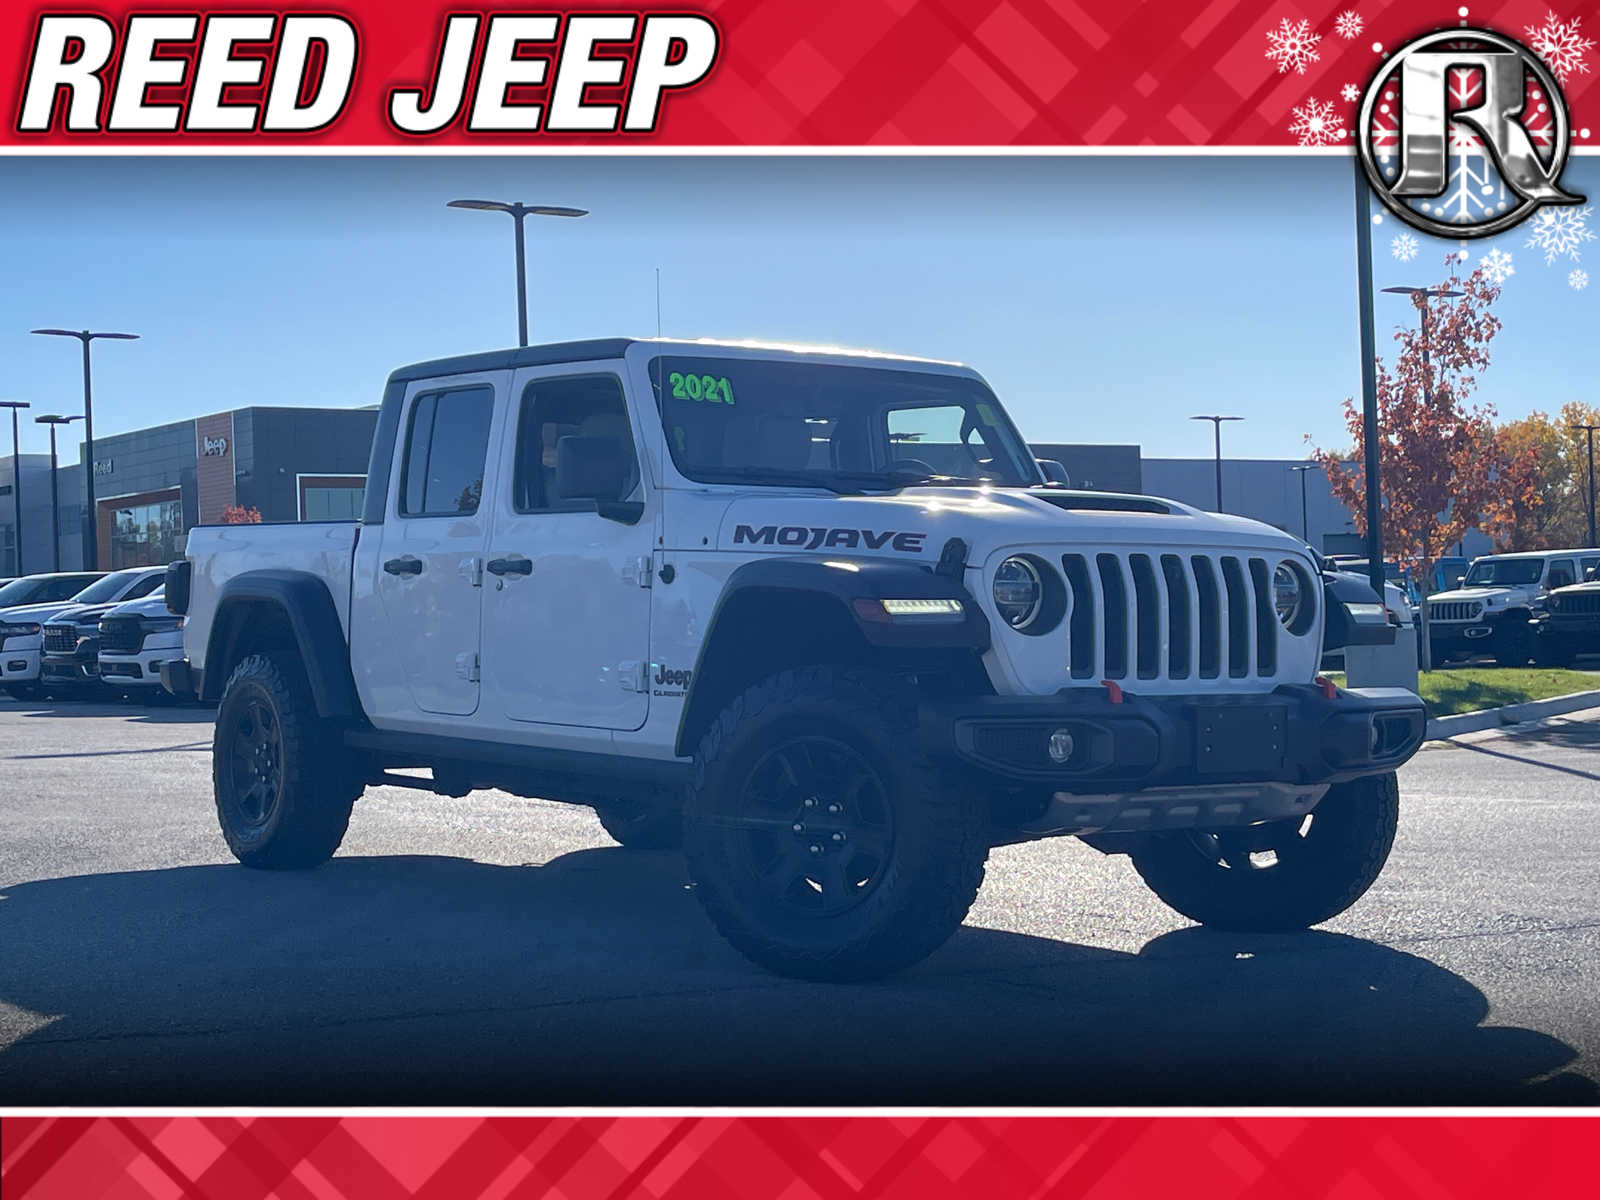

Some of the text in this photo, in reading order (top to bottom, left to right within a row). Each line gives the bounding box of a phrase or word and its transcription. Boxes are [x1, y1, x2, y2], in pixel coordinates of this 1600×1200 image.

[669, 372, 735, 405] 2021
[200, 435, 227, 457] Jeep
[733, 525, 927, 552] MOJAVE
[655, 664, 692, 690] Jeep
